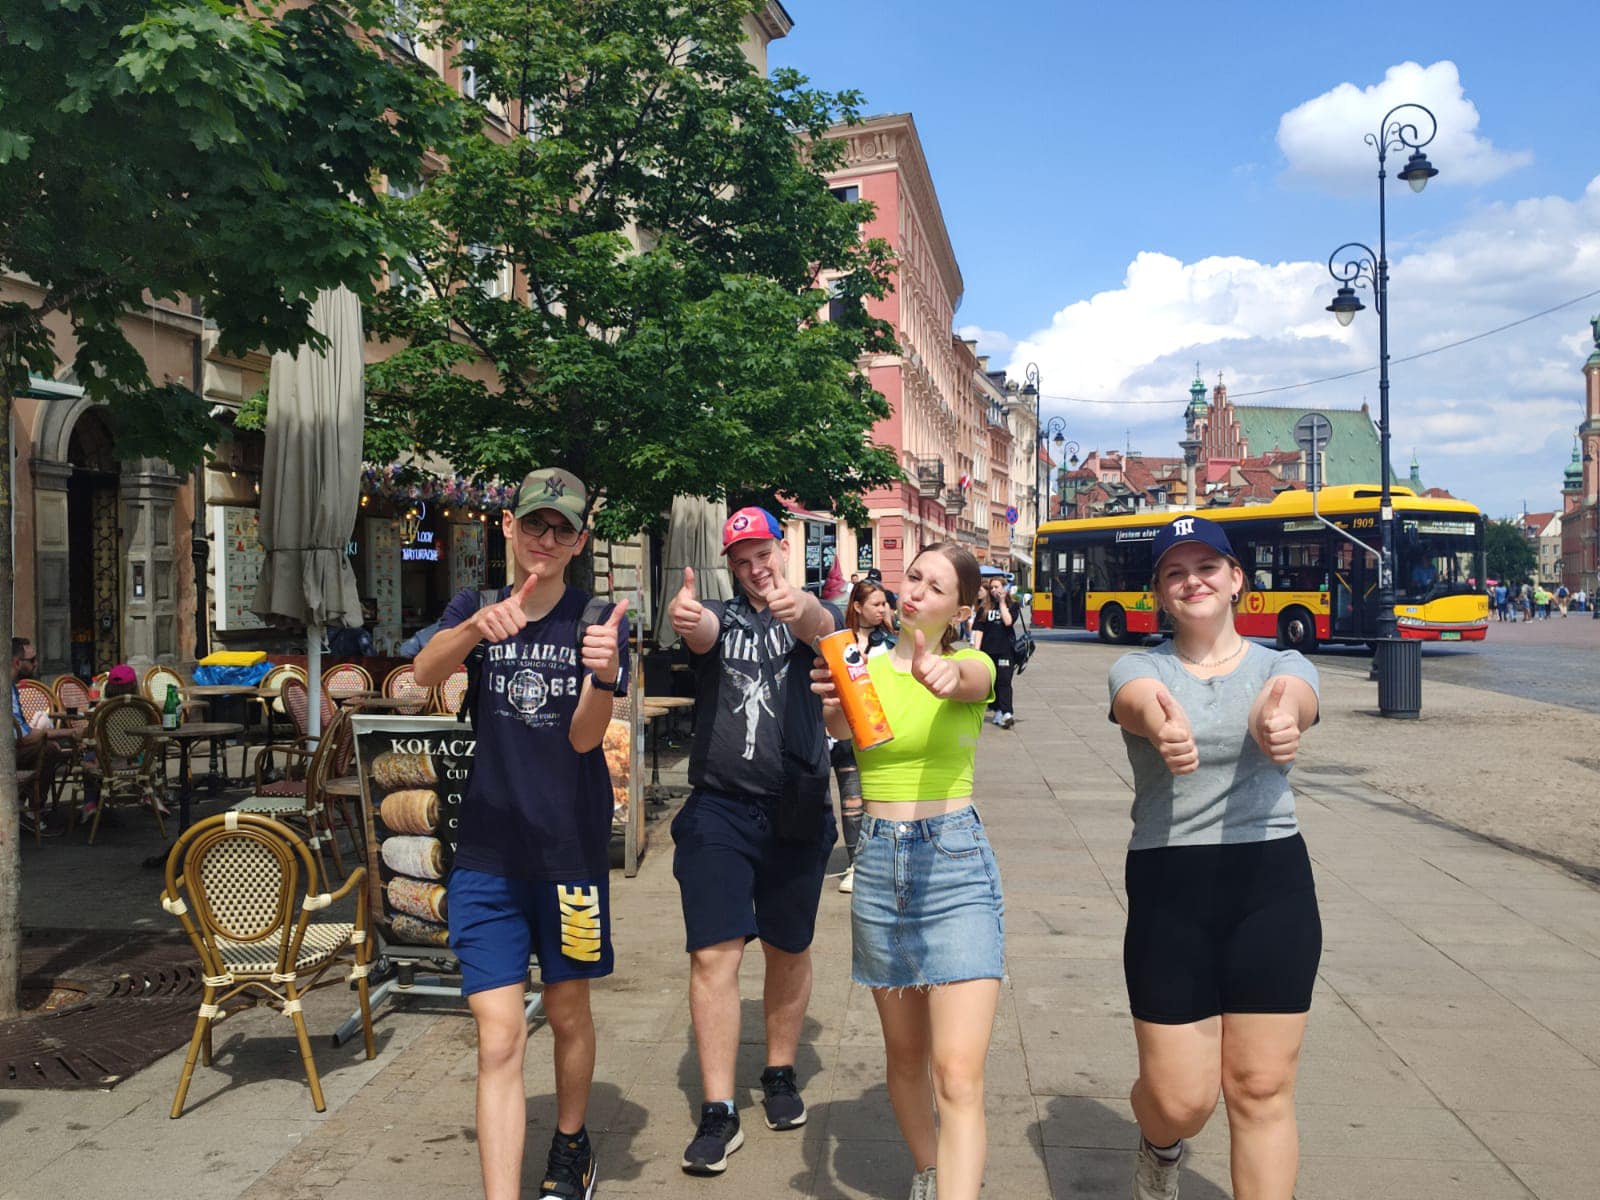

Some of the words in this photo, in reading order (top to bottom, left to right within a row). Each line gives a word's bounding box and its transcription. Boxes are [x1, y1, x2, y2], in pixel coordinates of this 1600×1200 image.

[1353, 518, 1374, 528] 1909
[489, 642, 517, 661] TOM
[391, 738, 477, 756] KOŁACZ
[557, 884, 601, 962] NIKE
